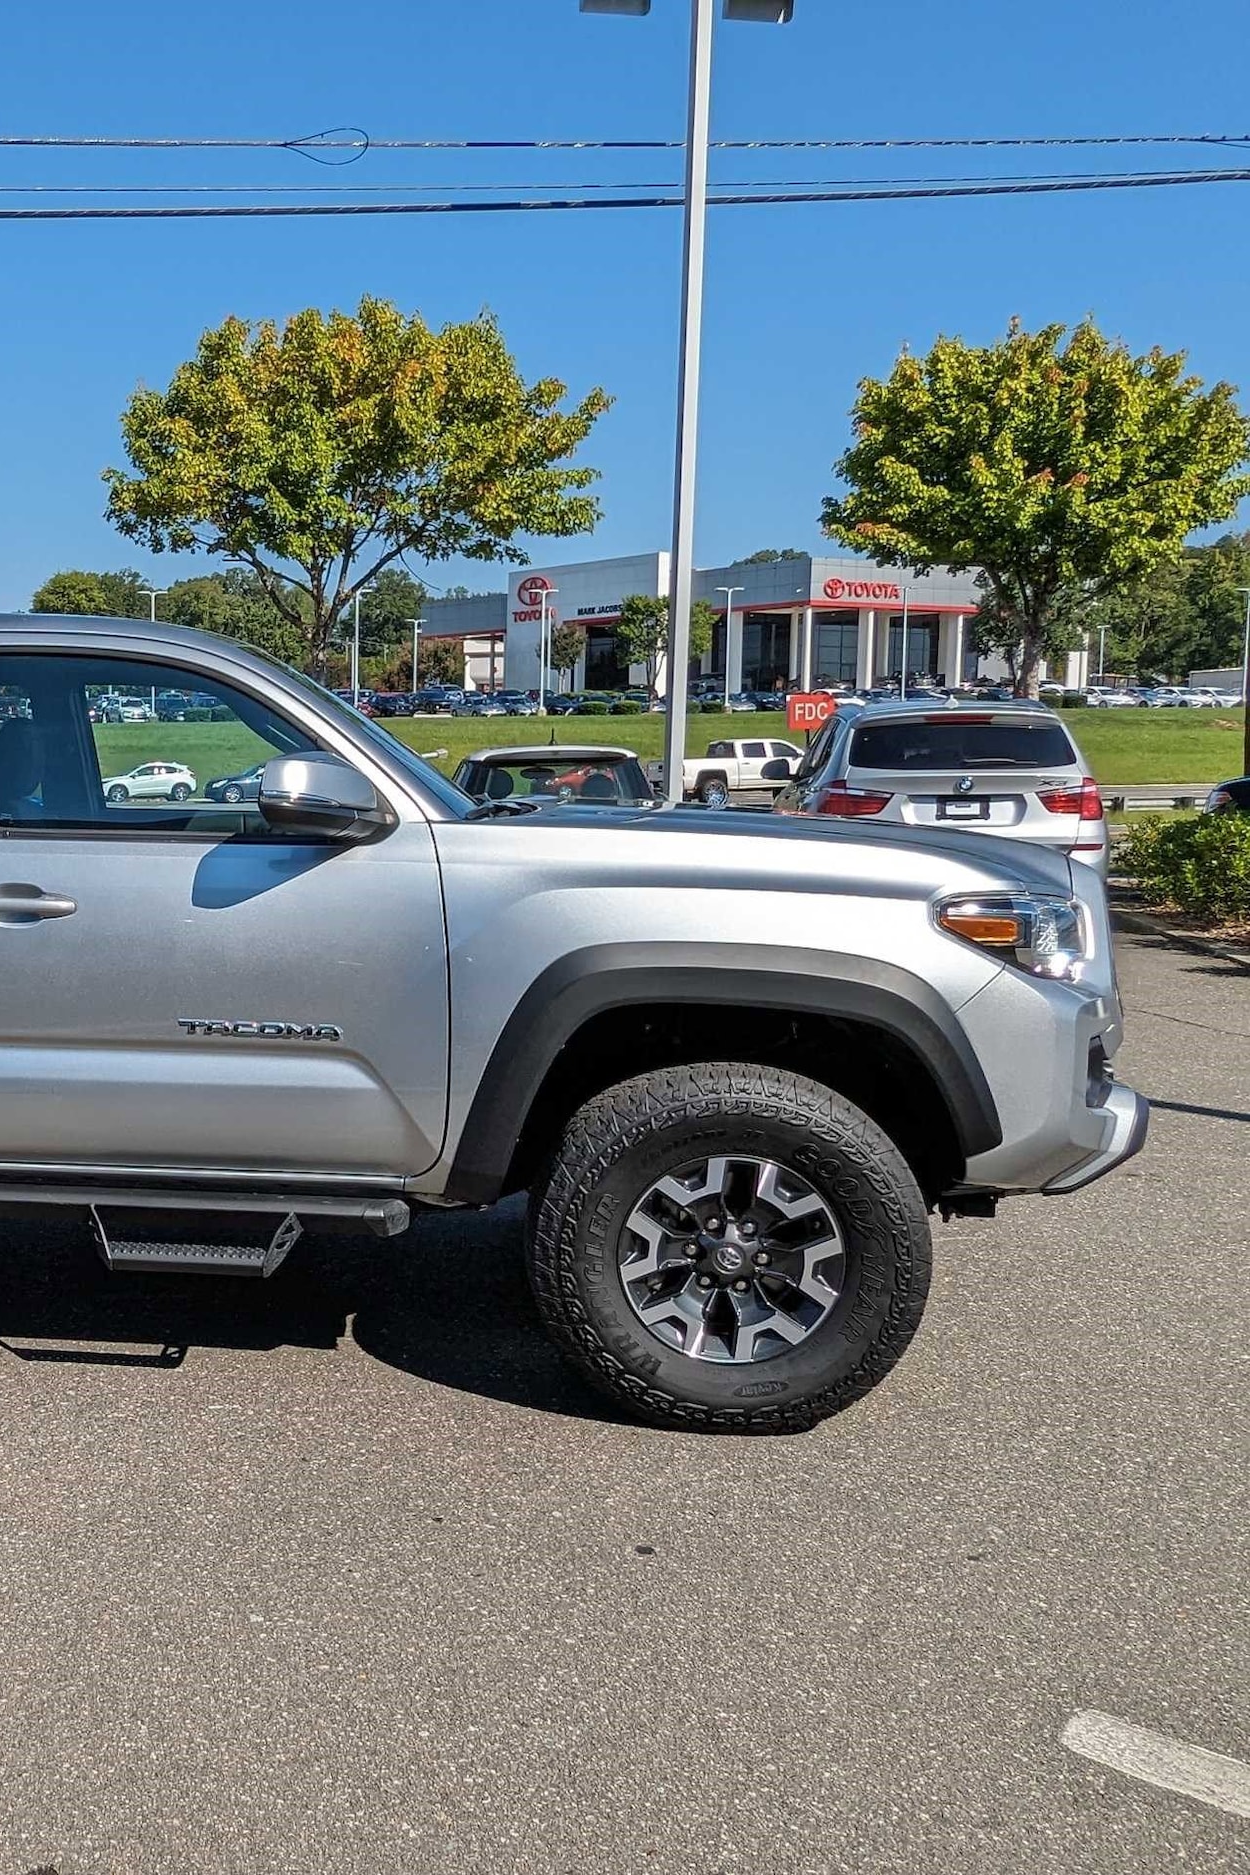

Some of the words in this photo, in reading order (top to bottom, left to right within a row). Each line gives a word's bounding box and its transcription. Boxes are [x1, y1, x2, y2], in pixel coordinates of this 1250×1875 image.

[846, 581, 900, 599] TOYOTA
[511, 608, 557, 623] TOYO
[577, 607, 595, 616] MARK
[597, 603, 623, 614] JACOBS
[794, 702, 829, 721] FDC
[178, 1018, 344, 1042] TACOMA
